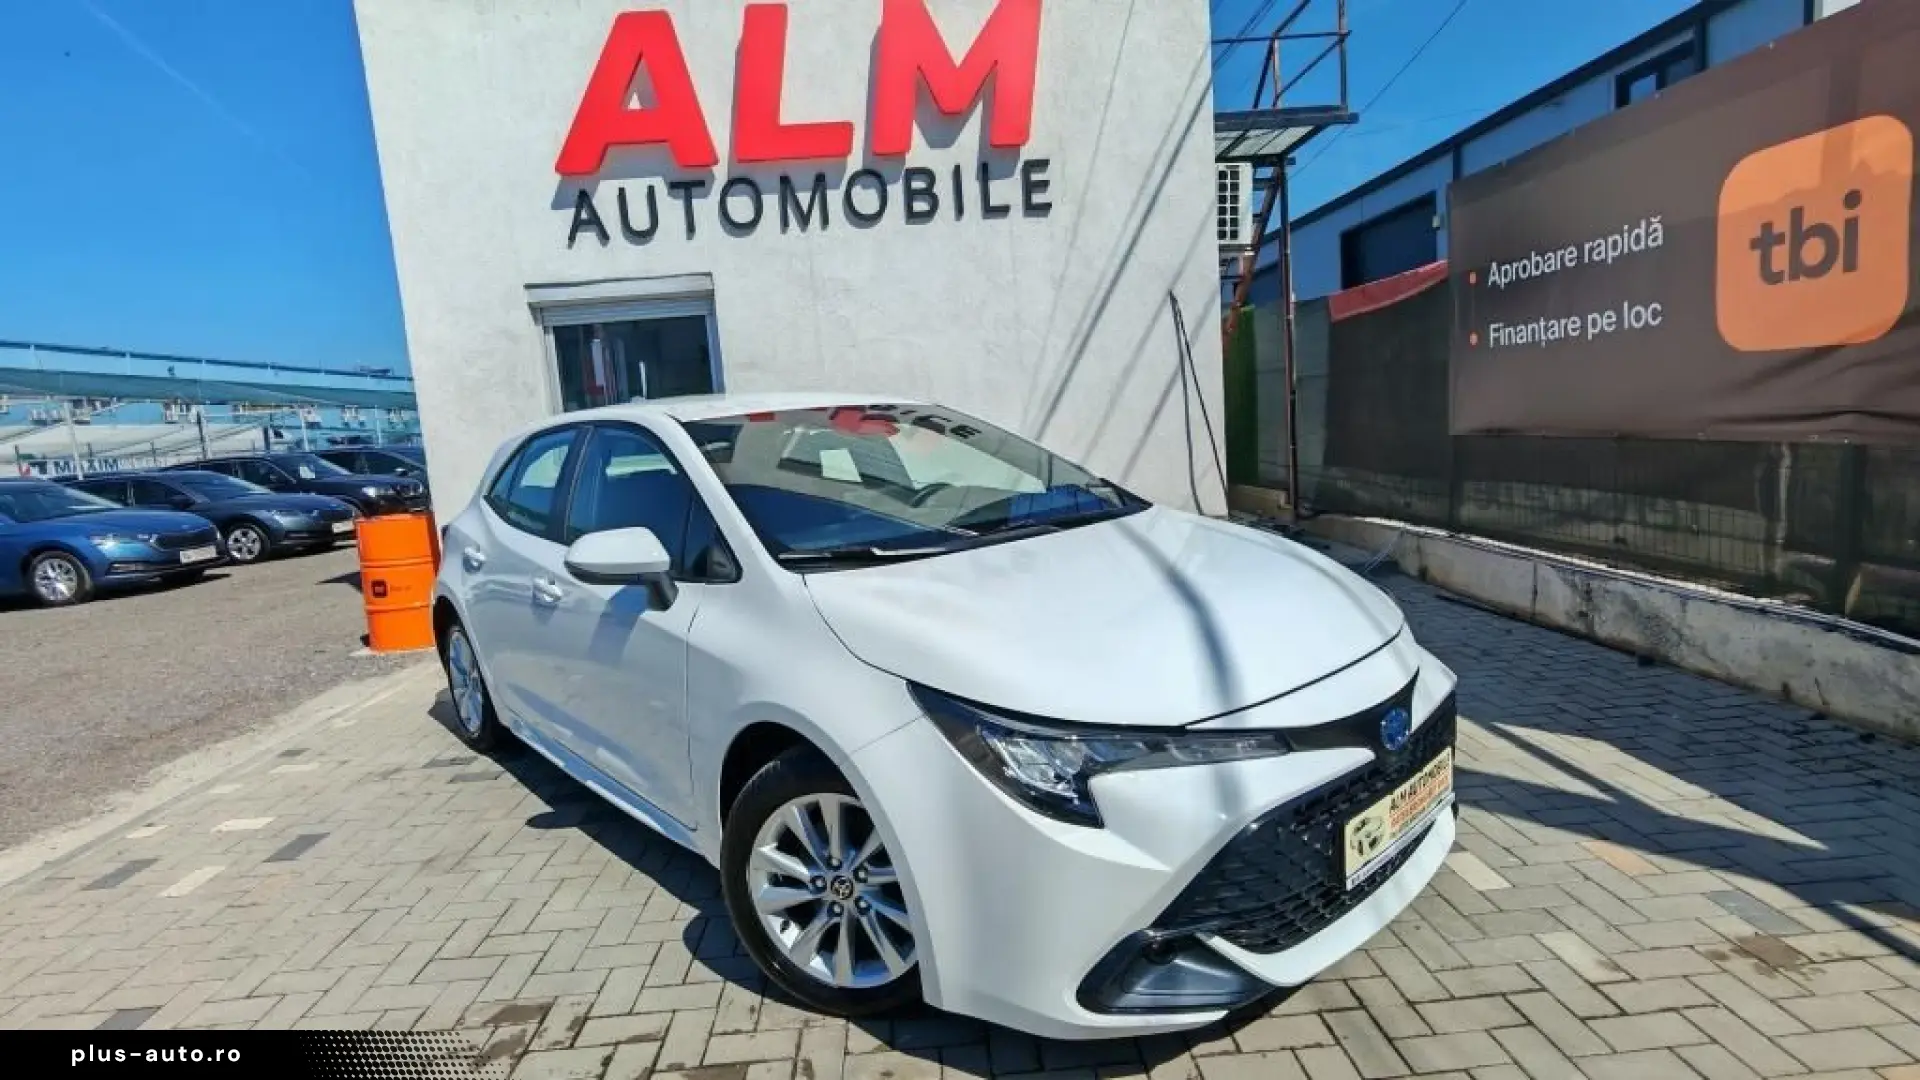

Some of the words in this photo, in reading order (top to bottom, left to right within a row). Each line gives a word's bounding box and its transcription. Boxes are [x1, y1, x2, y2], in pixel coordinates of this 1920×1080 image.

[555, 0, 1043, 175] ALM
[568, 158, 1053, 249] AUTOMOBILE
[1750, 189, 1862, 285] tbi
[1488, 245, 1578, 289] Aprobare
[1584, 216, 1664, 264] rapidă
[1490, 315, 1581, 348] Finanțare
[1587, 309, 1617, 340] pe
[1623, 301, 1662, 331] loc
